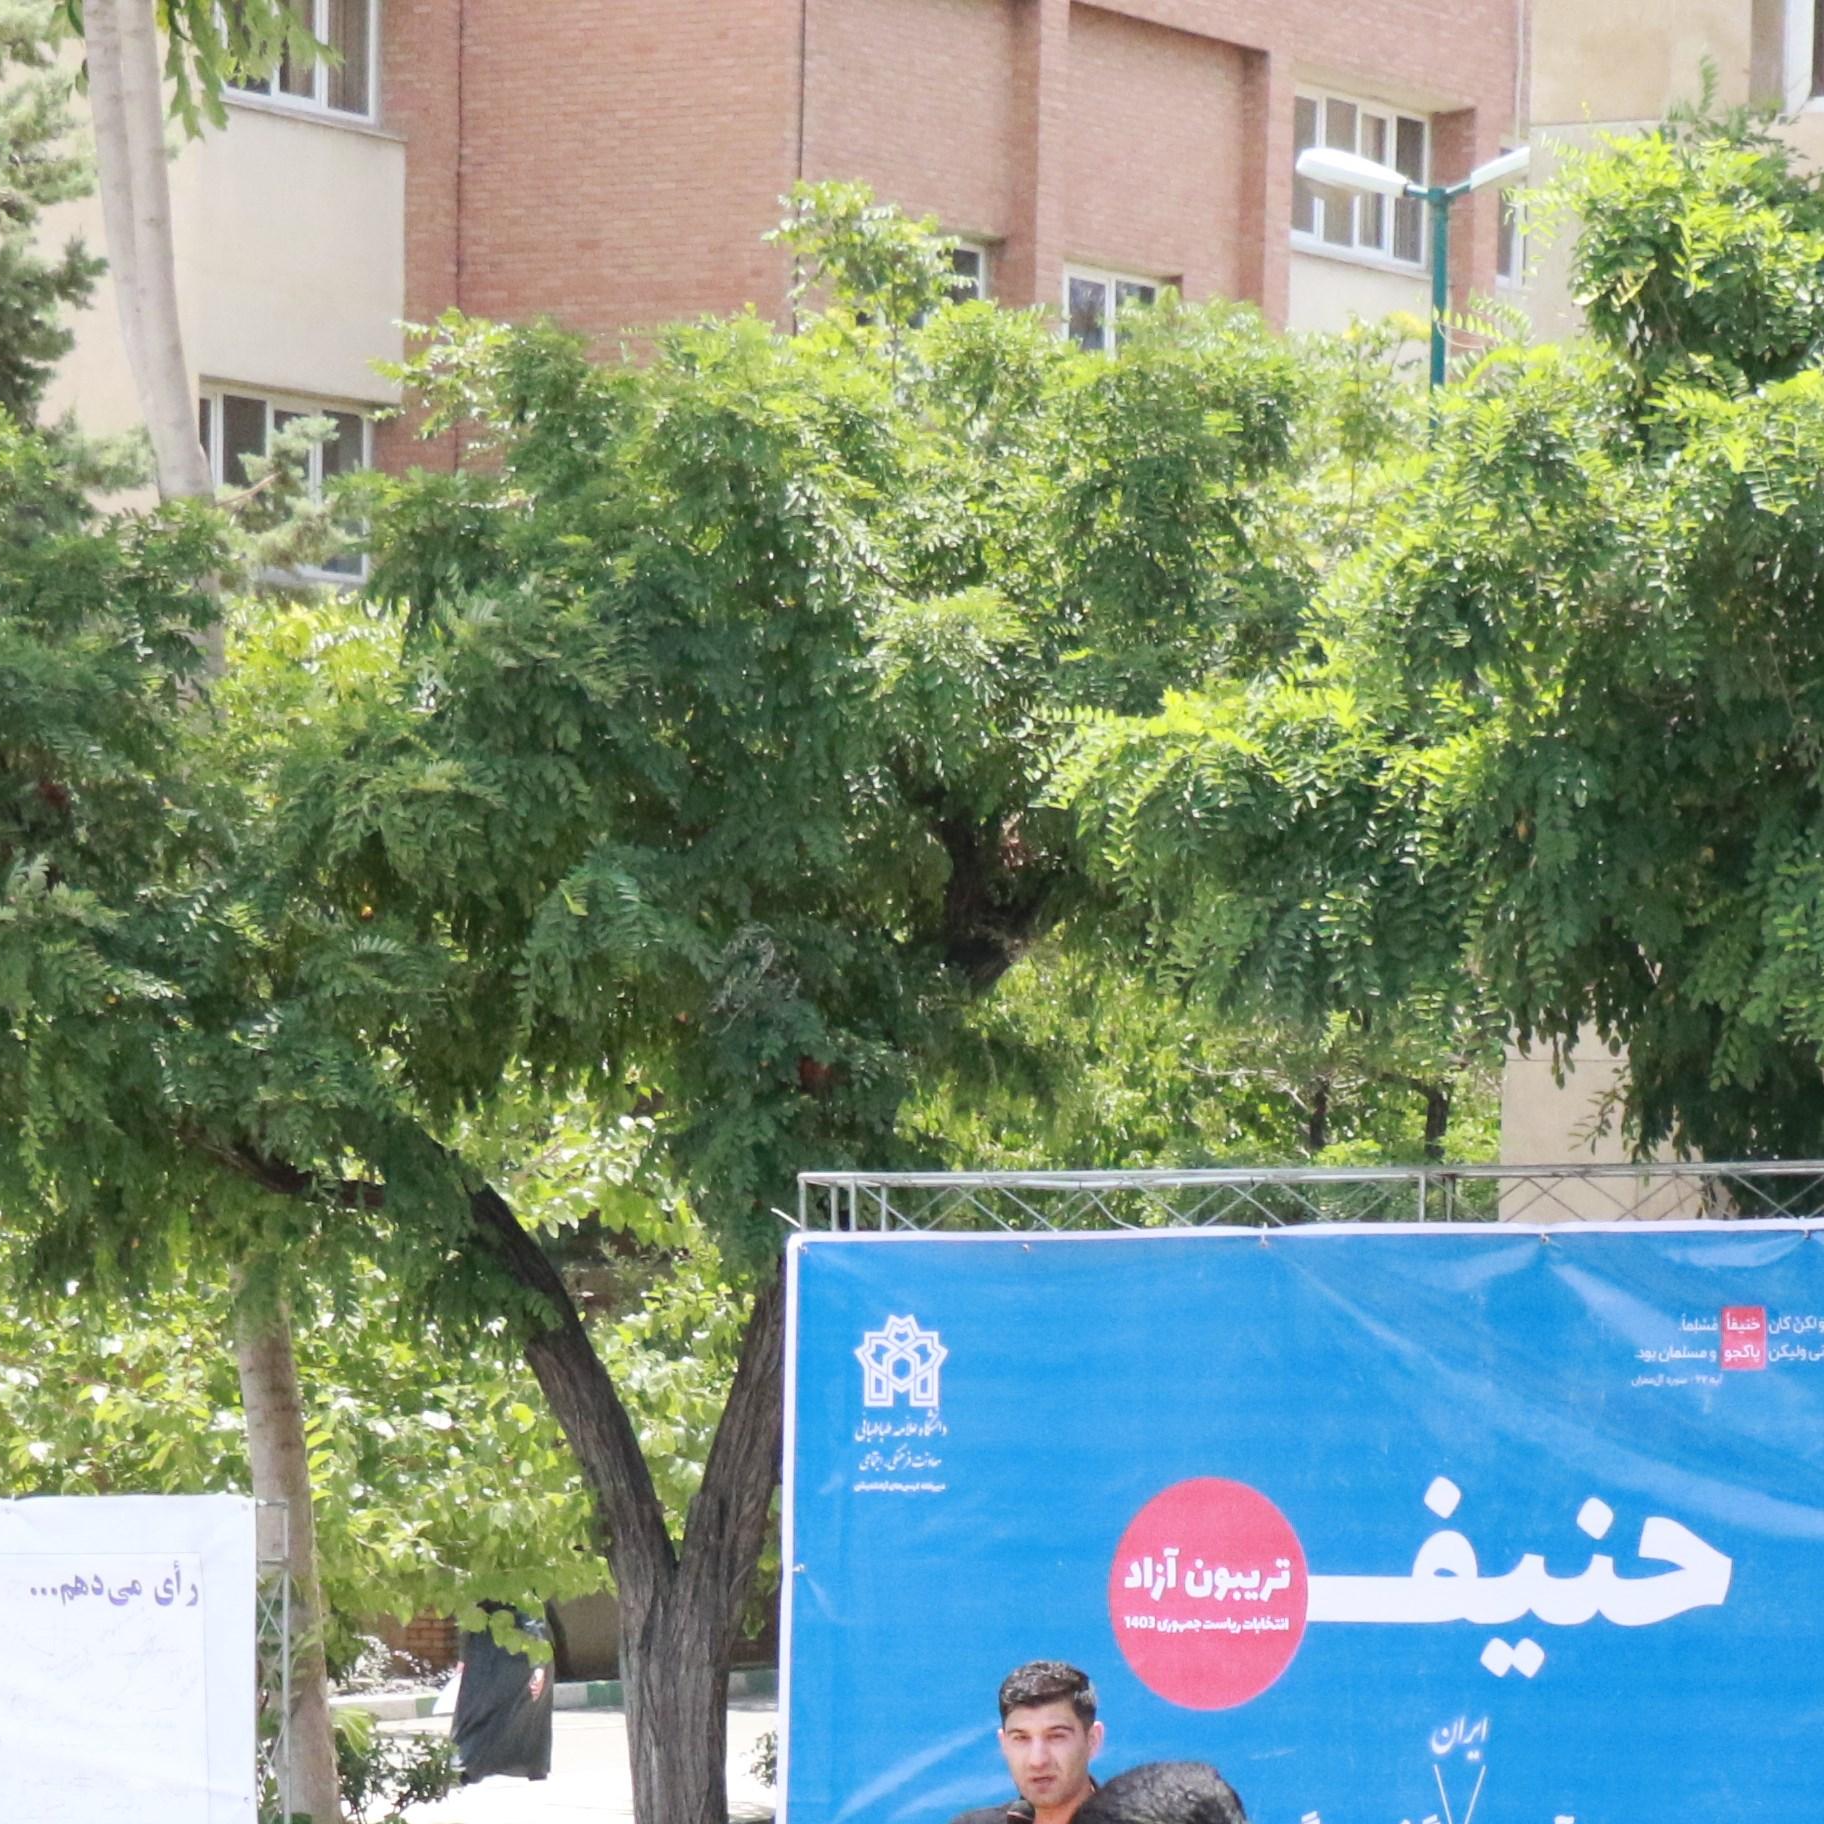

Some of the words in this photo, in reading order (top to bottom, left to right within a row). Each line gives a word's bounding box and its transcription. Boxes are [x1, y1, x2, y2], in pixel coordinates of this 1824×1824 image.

[154, 1559, 199, 1608] رأی
[1124, 1547, 1180, 1602] آزاد
[1184, 1558, 1291, 1603] تریبون
[1307, 1475, 1733, 1679] حنیف
[1123, 1615, 1155, 1630] 1403
[1156, 1618, 1202, 1634] جمهوری
[1202, 1617, 1241, 1635] ریاست
[1242, 1616, 1289, 1635] انتخابات
[1429, 1714, 1489, 1761] ایران
